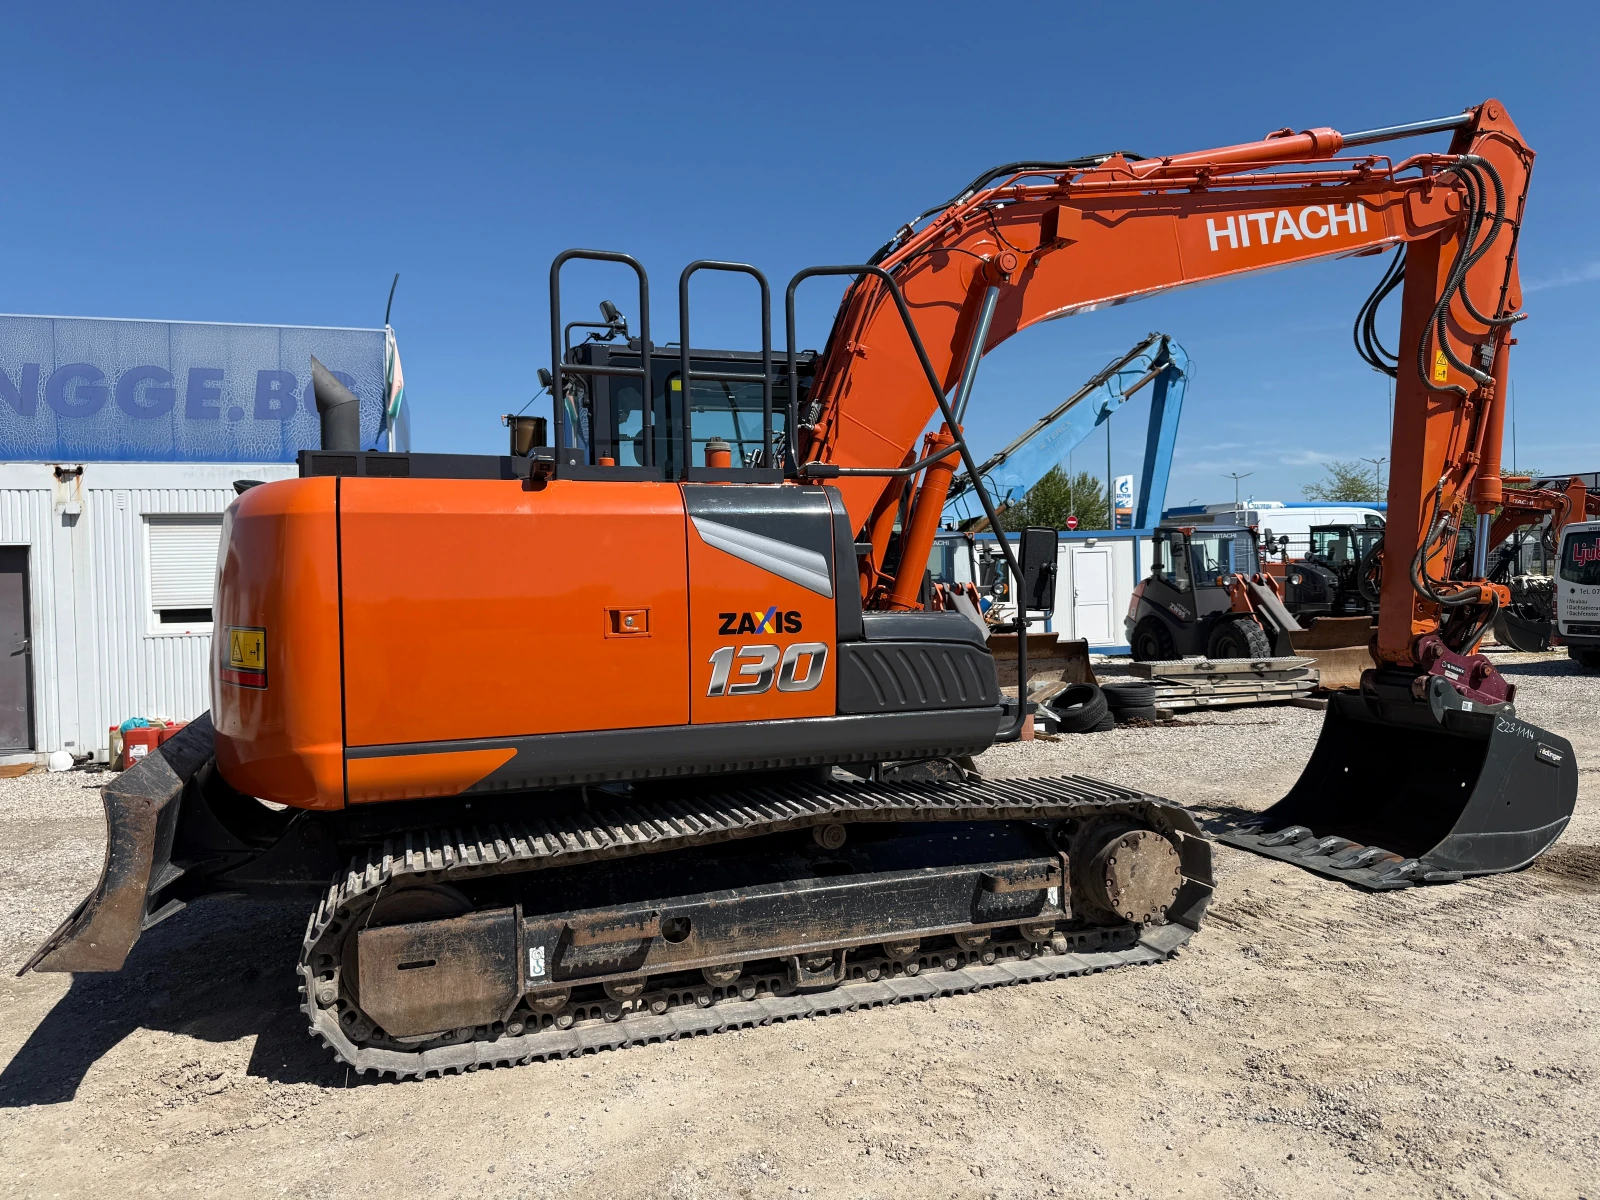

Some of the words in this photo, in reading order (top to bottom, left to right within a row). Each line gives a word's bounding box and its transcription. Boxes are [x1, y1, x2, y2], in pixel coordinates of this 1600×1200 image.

[1206, 201, 1368, 251] HITACHI
[1045, 420, 1072, 443] TEREX
[718, 606, 802, 636] ZAXIS
[706, 642, 829, 697] 130
